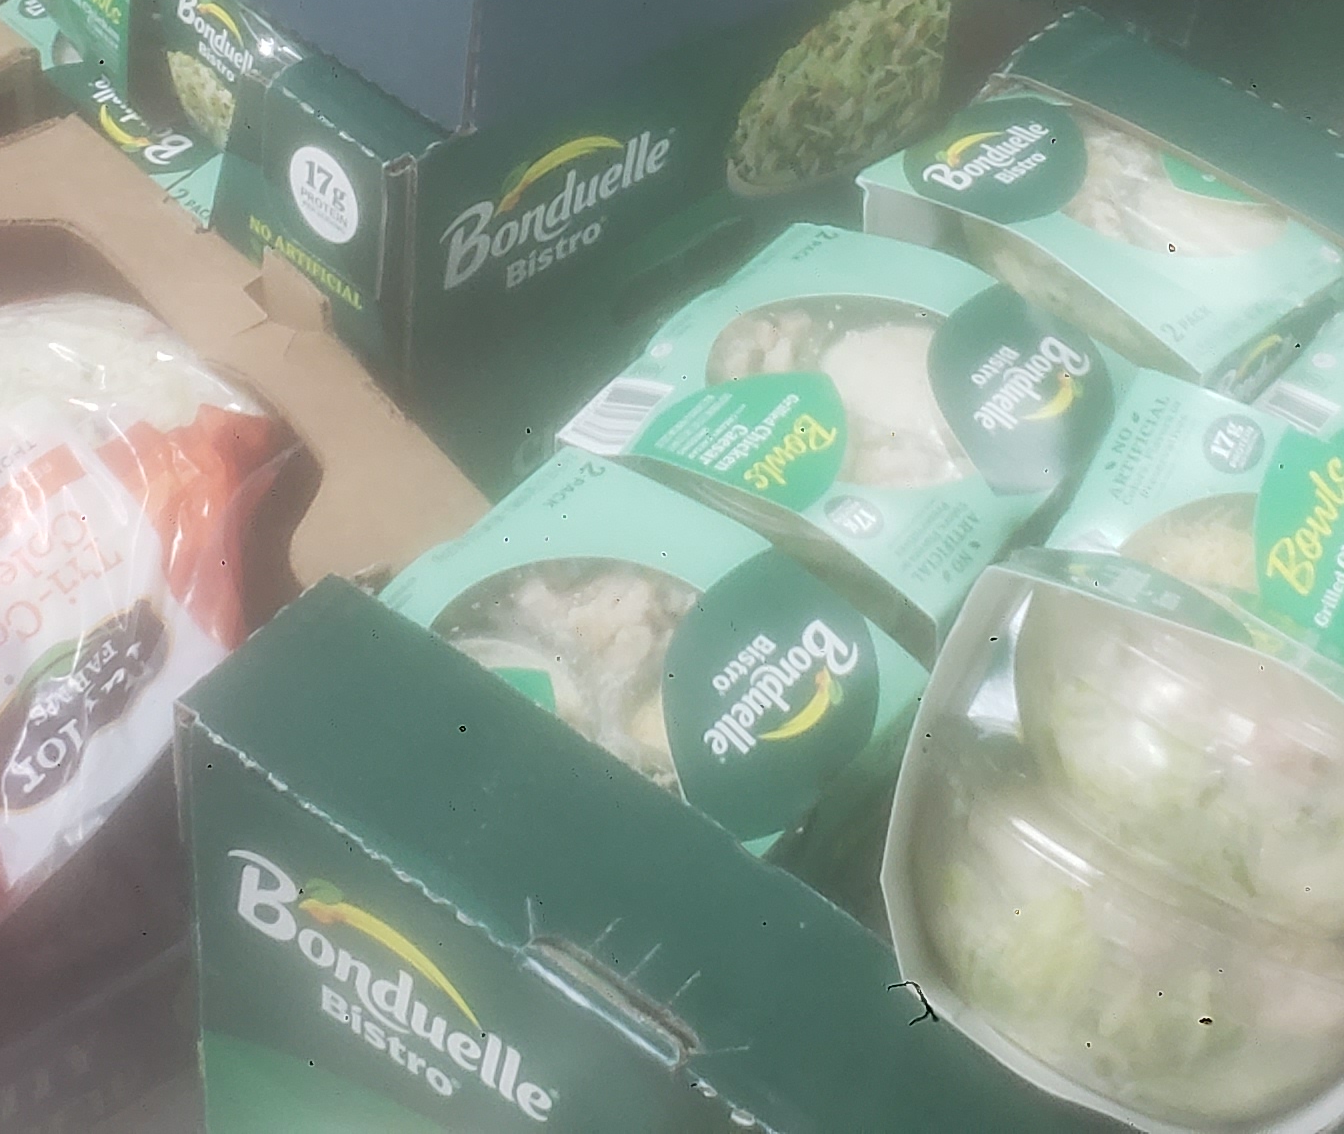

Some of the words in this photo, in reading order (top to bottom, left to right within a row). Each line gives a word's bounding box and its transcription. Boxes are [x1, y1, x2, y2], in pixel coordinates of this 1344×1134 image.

[198, 40, 235, 83] Bistro
[923, 120, 1049, 191] Bonduelle
[993, 150, 1047, 185] Bistro
[184, 199, 211, 221] PAC
[300, 186, 349, 229] PROTEIN
[305, 160, 348, 214] 17g
[439, 130, 670, 291] Bonduelle
[250, 215, 272, 243] NO
[275, 237, 363, 311] ARTIFICIAL
[506, 221, 602, 289] Bistro
[1161, 321, 1185, 344] 2
[971, 344, 1021, 388] Bistro
[973, 335, 1091, 432] Bonduelle
[699, 423, 749, 466] Caesar
[713, 424, 773, 471] Chicken
[743, 413, 837, 490] Bowls
[1110, 395, 1171, 501] ARTIFICIAL
[1111, 427, 1133, 454] NO
[1210, 420, 1245, 459] 17g
[582, 461, 607, 479] 2
[227, 849, 552, 1122] Bonduelle
[321, 984, 453, 1096] Bistro
